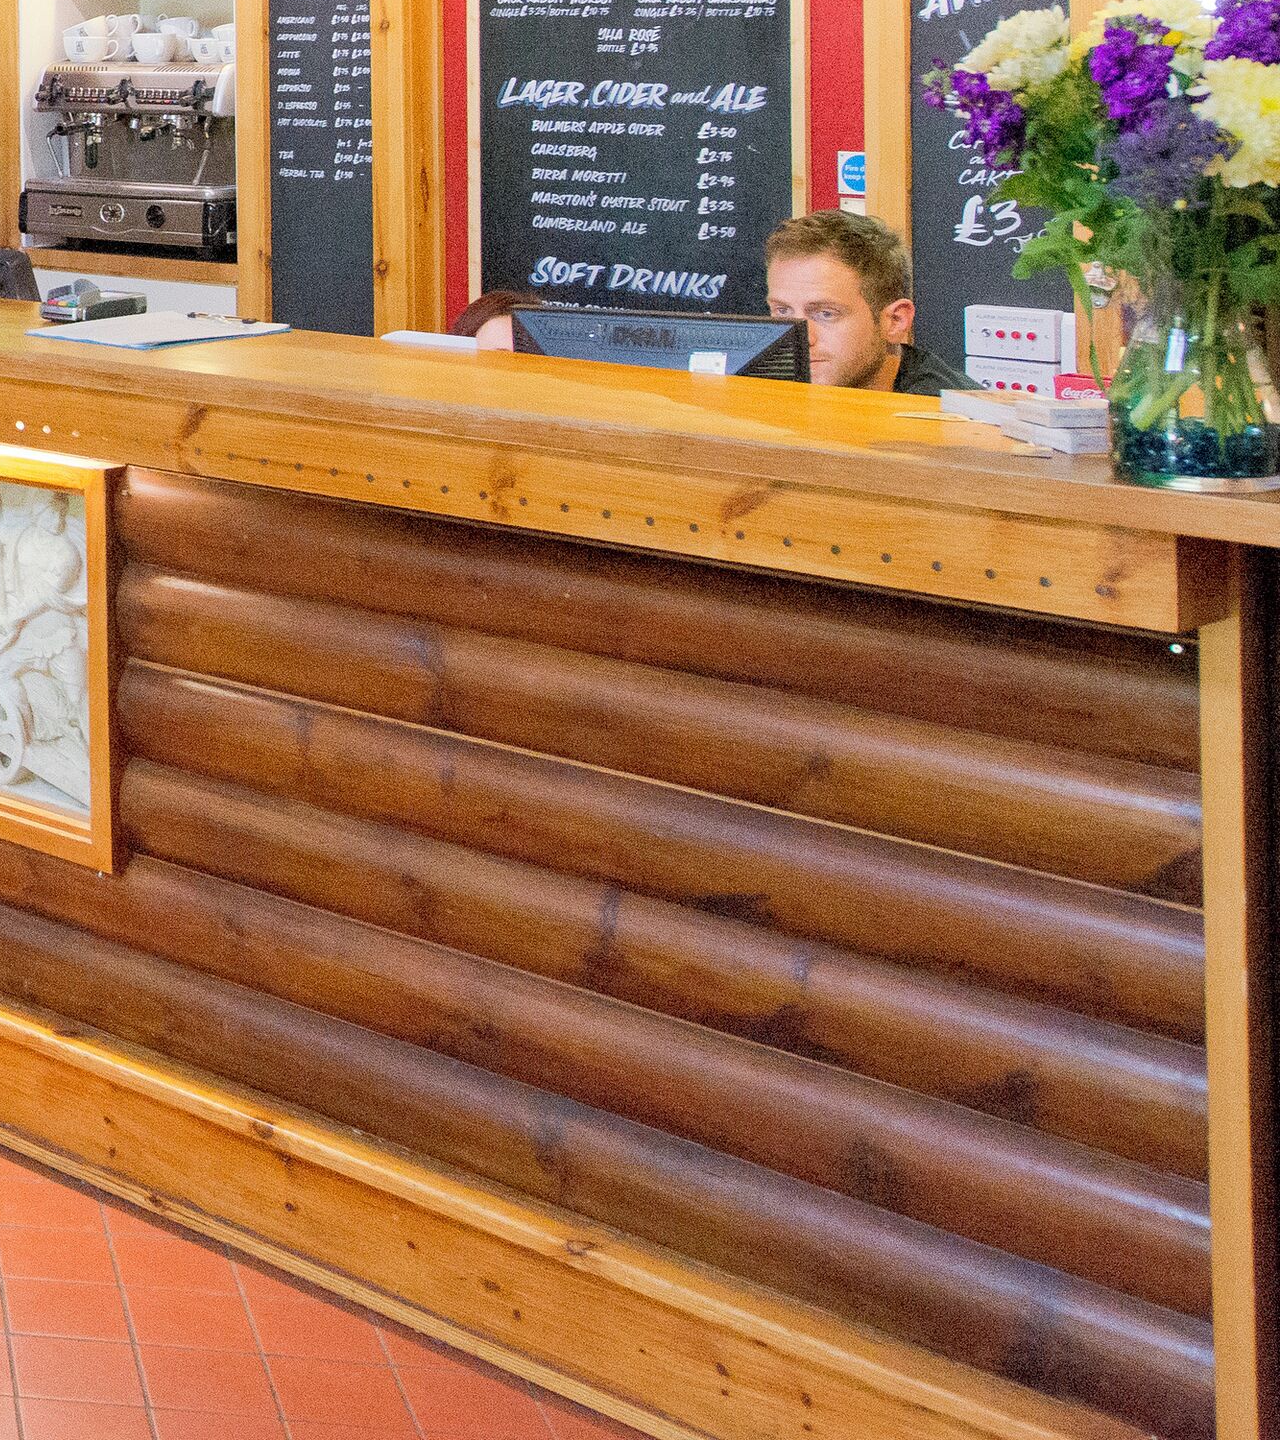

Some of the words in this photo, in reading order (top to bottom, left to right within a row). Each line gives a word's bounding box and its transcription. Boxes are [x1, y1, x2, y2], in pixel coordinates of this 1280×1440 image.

[490, 8, 520, 18] SINGLE
[634, 7, 669, 18] SINGLE
[705, 8, 742, 17] BOTTLE
[598, 28, 623, 40] YHA
[629, 26, 662, 42] ROSÉ
[597, 44, 626, 52] BOTTLE
[590, 79, 667, 110] CIDER
[670, 87, 709, 106] and
[706, 84, 769, 114] ALE
[277, 118, 291, 126] HOT
[531, 120, 586, 133] BULMERS
[588, 121, 626, 135] APPLE
[628, 123, 665, 137] CIDER
[279, 151, 293, 159] TEA
[531, 143, 598, 161] CARLSBERG
[279, 168, 308, 177] HERBAL
[309, 170, 325, 178] TEA
[531, 168, 566, 181] BIRRA
[571, 170, 627, 184] MORETTI
[531, 191, 598, 208] MARSTON'S
[601, 195, 646, 210] OYSTER
[648, 197, 690, 213] STOUT
[532, 214, 616, 233] CUMBERLAND
[621, 221, 648, 235] ALE
[527, 255, 605, 288] SOFT
[607, 262, 728, 301] DRINKS
